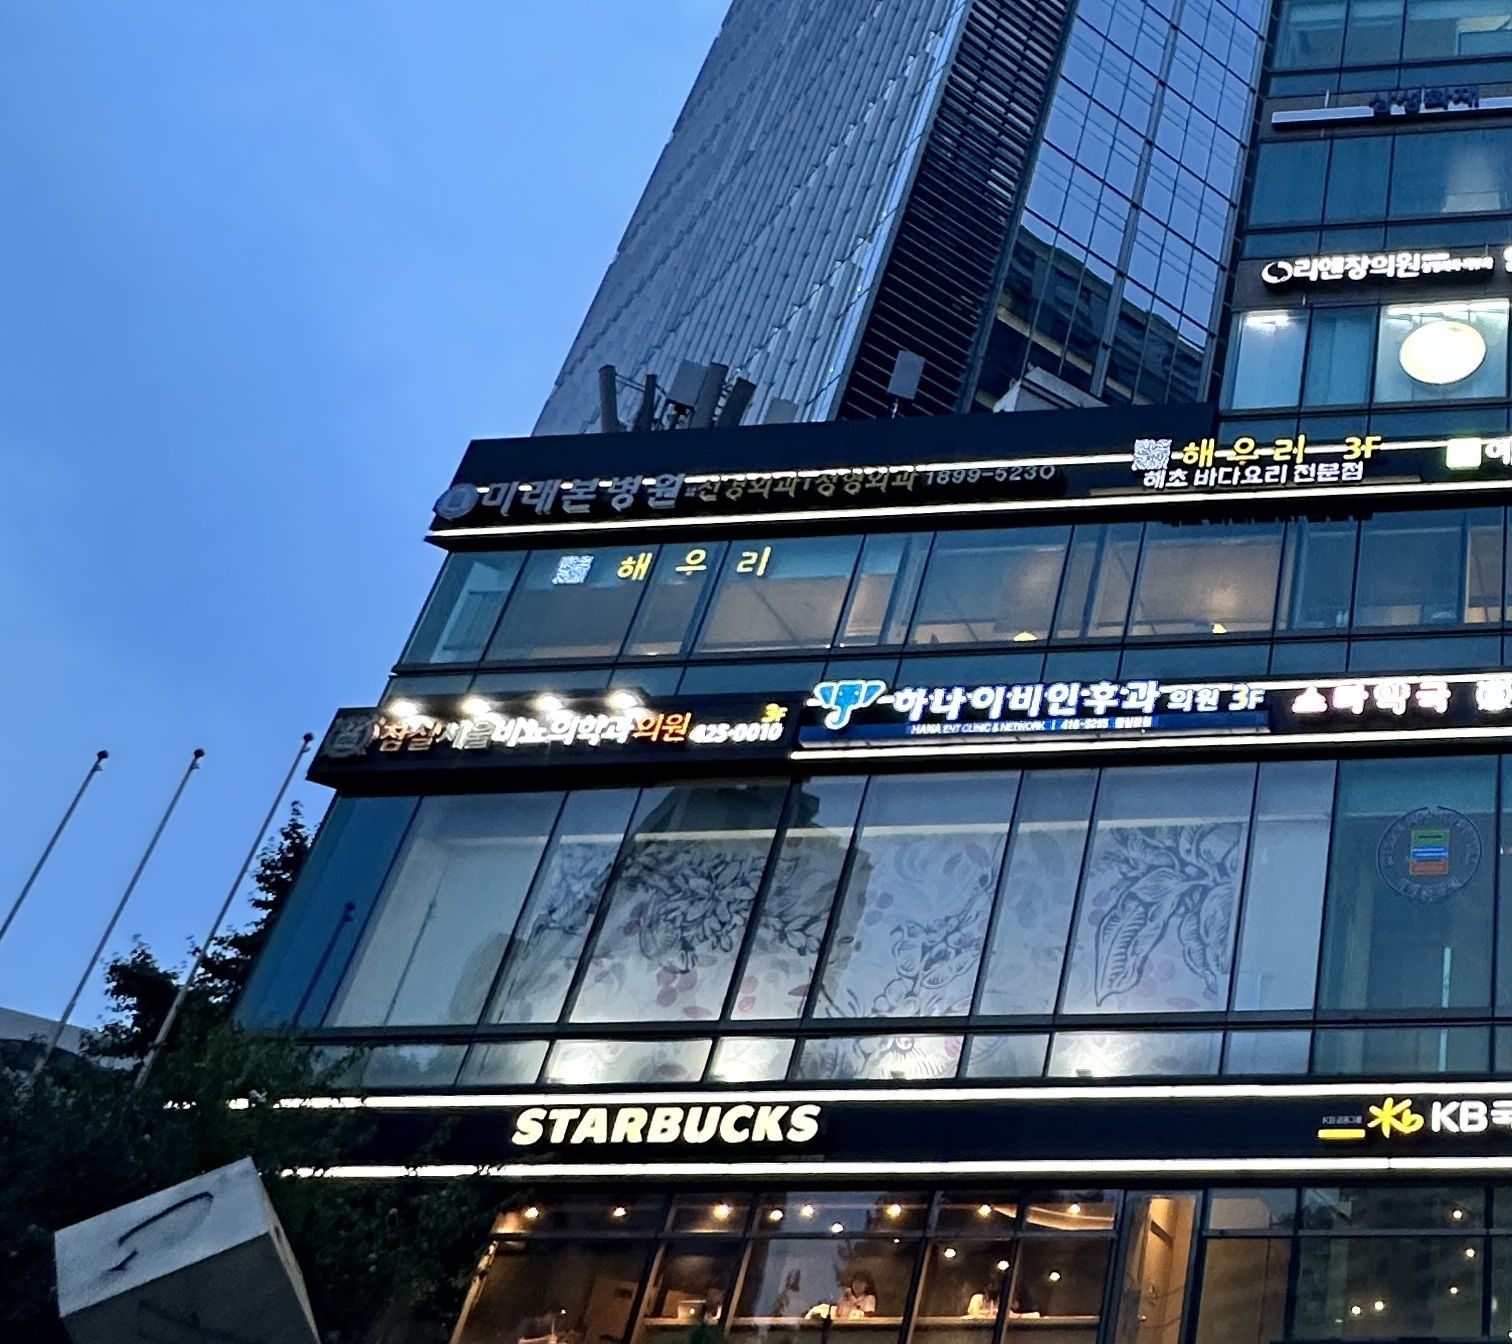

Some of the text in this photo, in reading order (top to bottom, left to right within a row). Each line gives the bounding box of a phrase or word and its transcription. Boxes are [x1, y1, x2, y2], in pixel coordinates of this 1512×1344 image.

[1293, 252, 1420, 282] 리엔장의원
[1342, 435, 1383, 461] 3F
[481, 471, 686, 518] 미래본병원
[924, 464, 1056, 486] 1899-5230
[1142, 460, 1364, 490] 해초 바다요리 전문점
[892, 678, 1161, 723] 하나이비인후과
[1166, 687, 1219, 712] 의원
[1227, 683, 1266, 711] 3F
[511, 1103, 823, 1146] STARBUCKS
